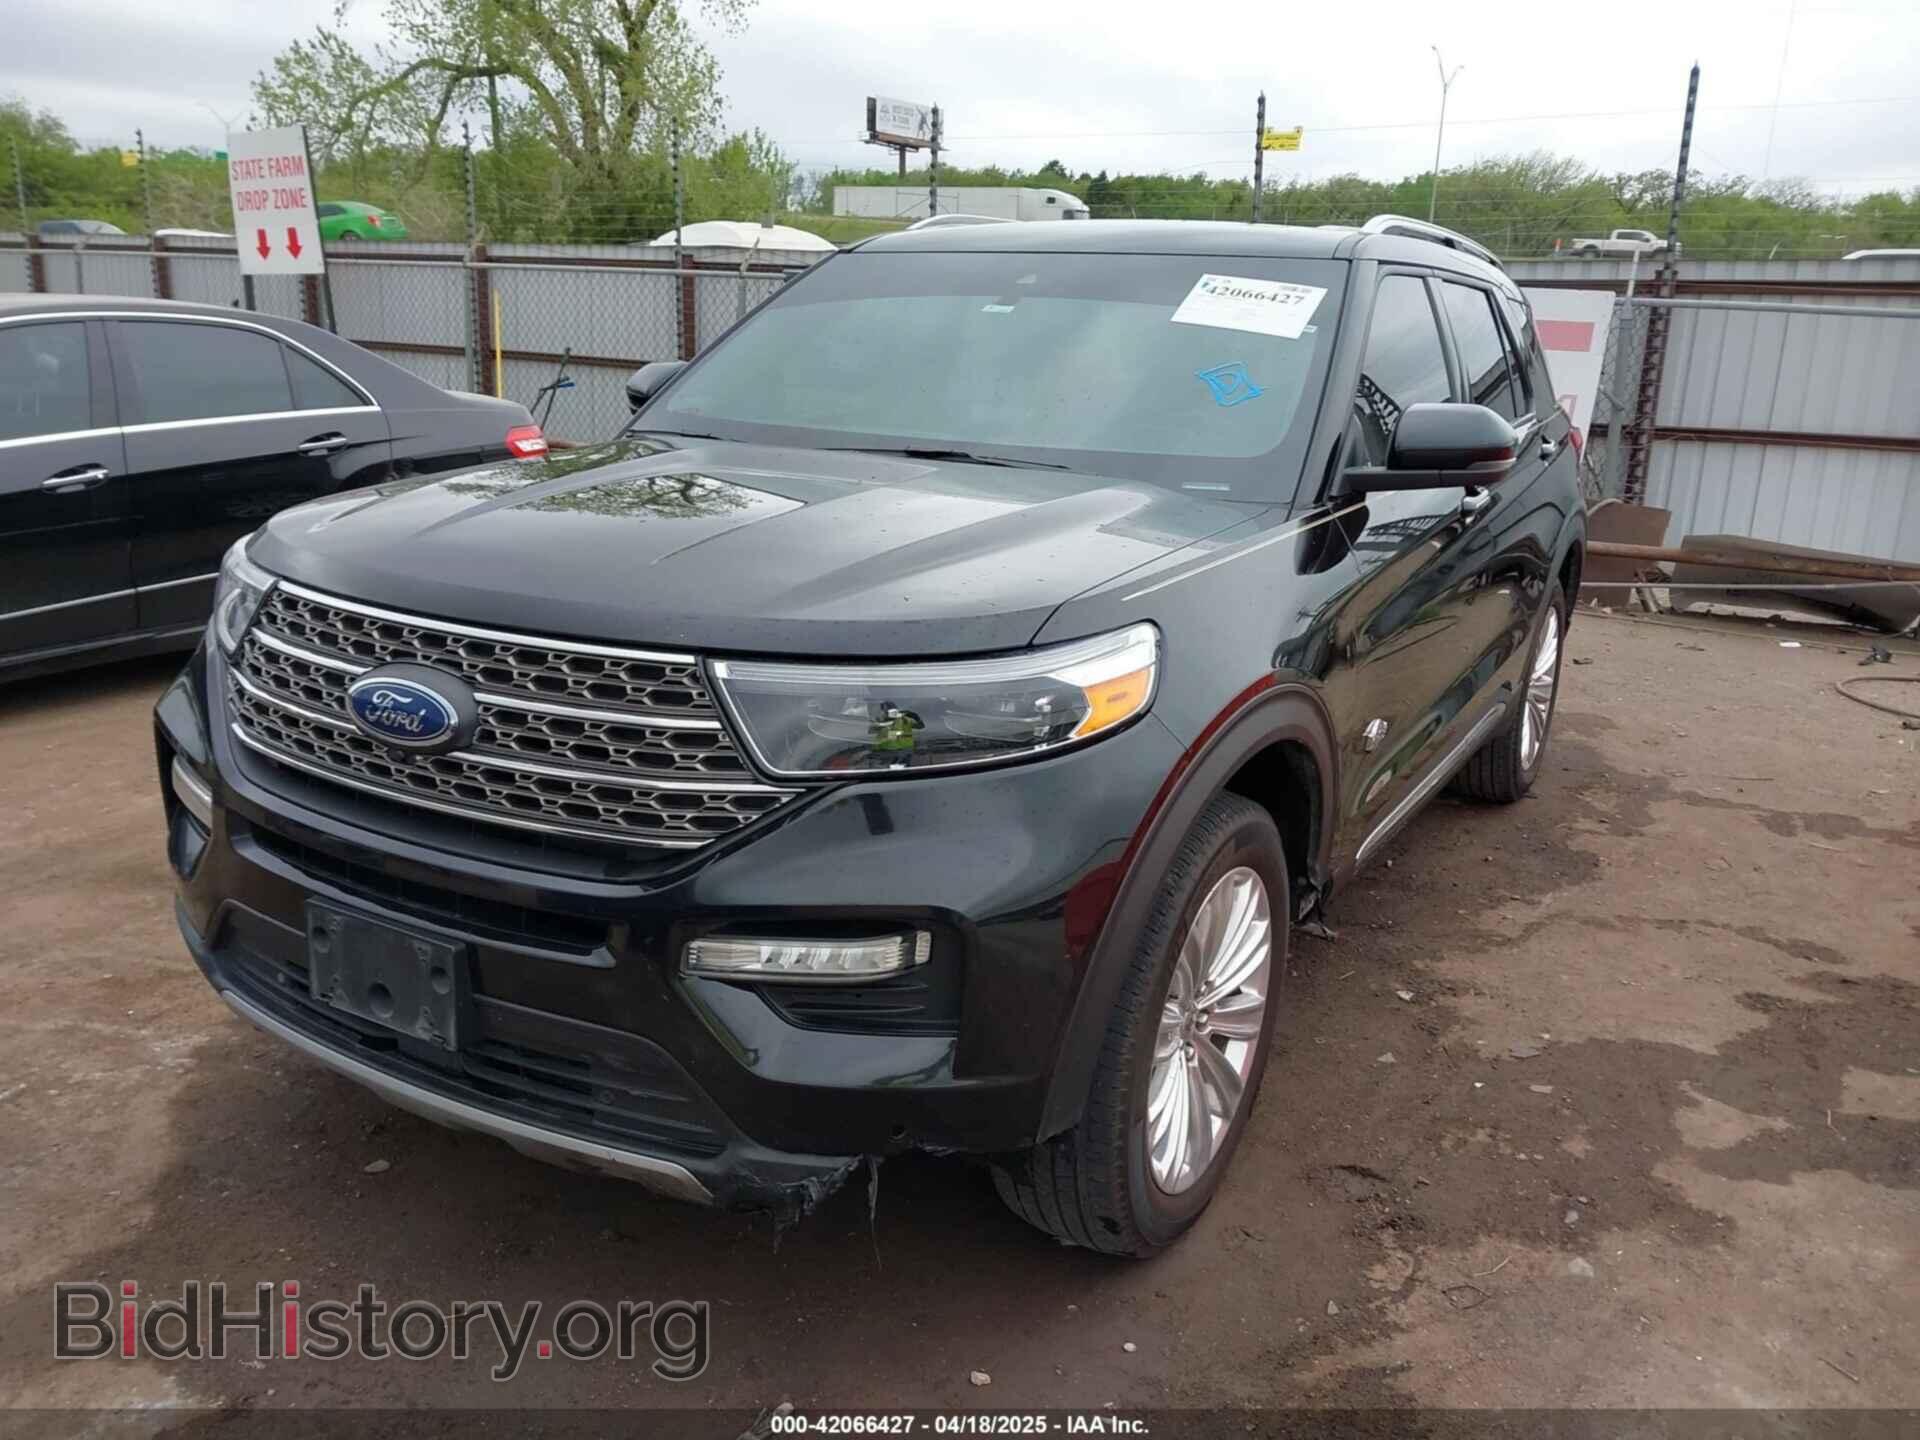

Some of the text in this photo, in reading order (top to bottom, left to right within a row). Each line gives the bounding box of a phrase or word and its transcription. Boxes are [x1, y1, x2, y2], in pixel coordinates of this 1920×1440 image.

[231, 155, 305, 181] STATE FARM
[236, 187, 308, 212] DROP ZONE
[1205, 286, 1305, 305] 42066427
[364, 689, 428, 732] Ford
